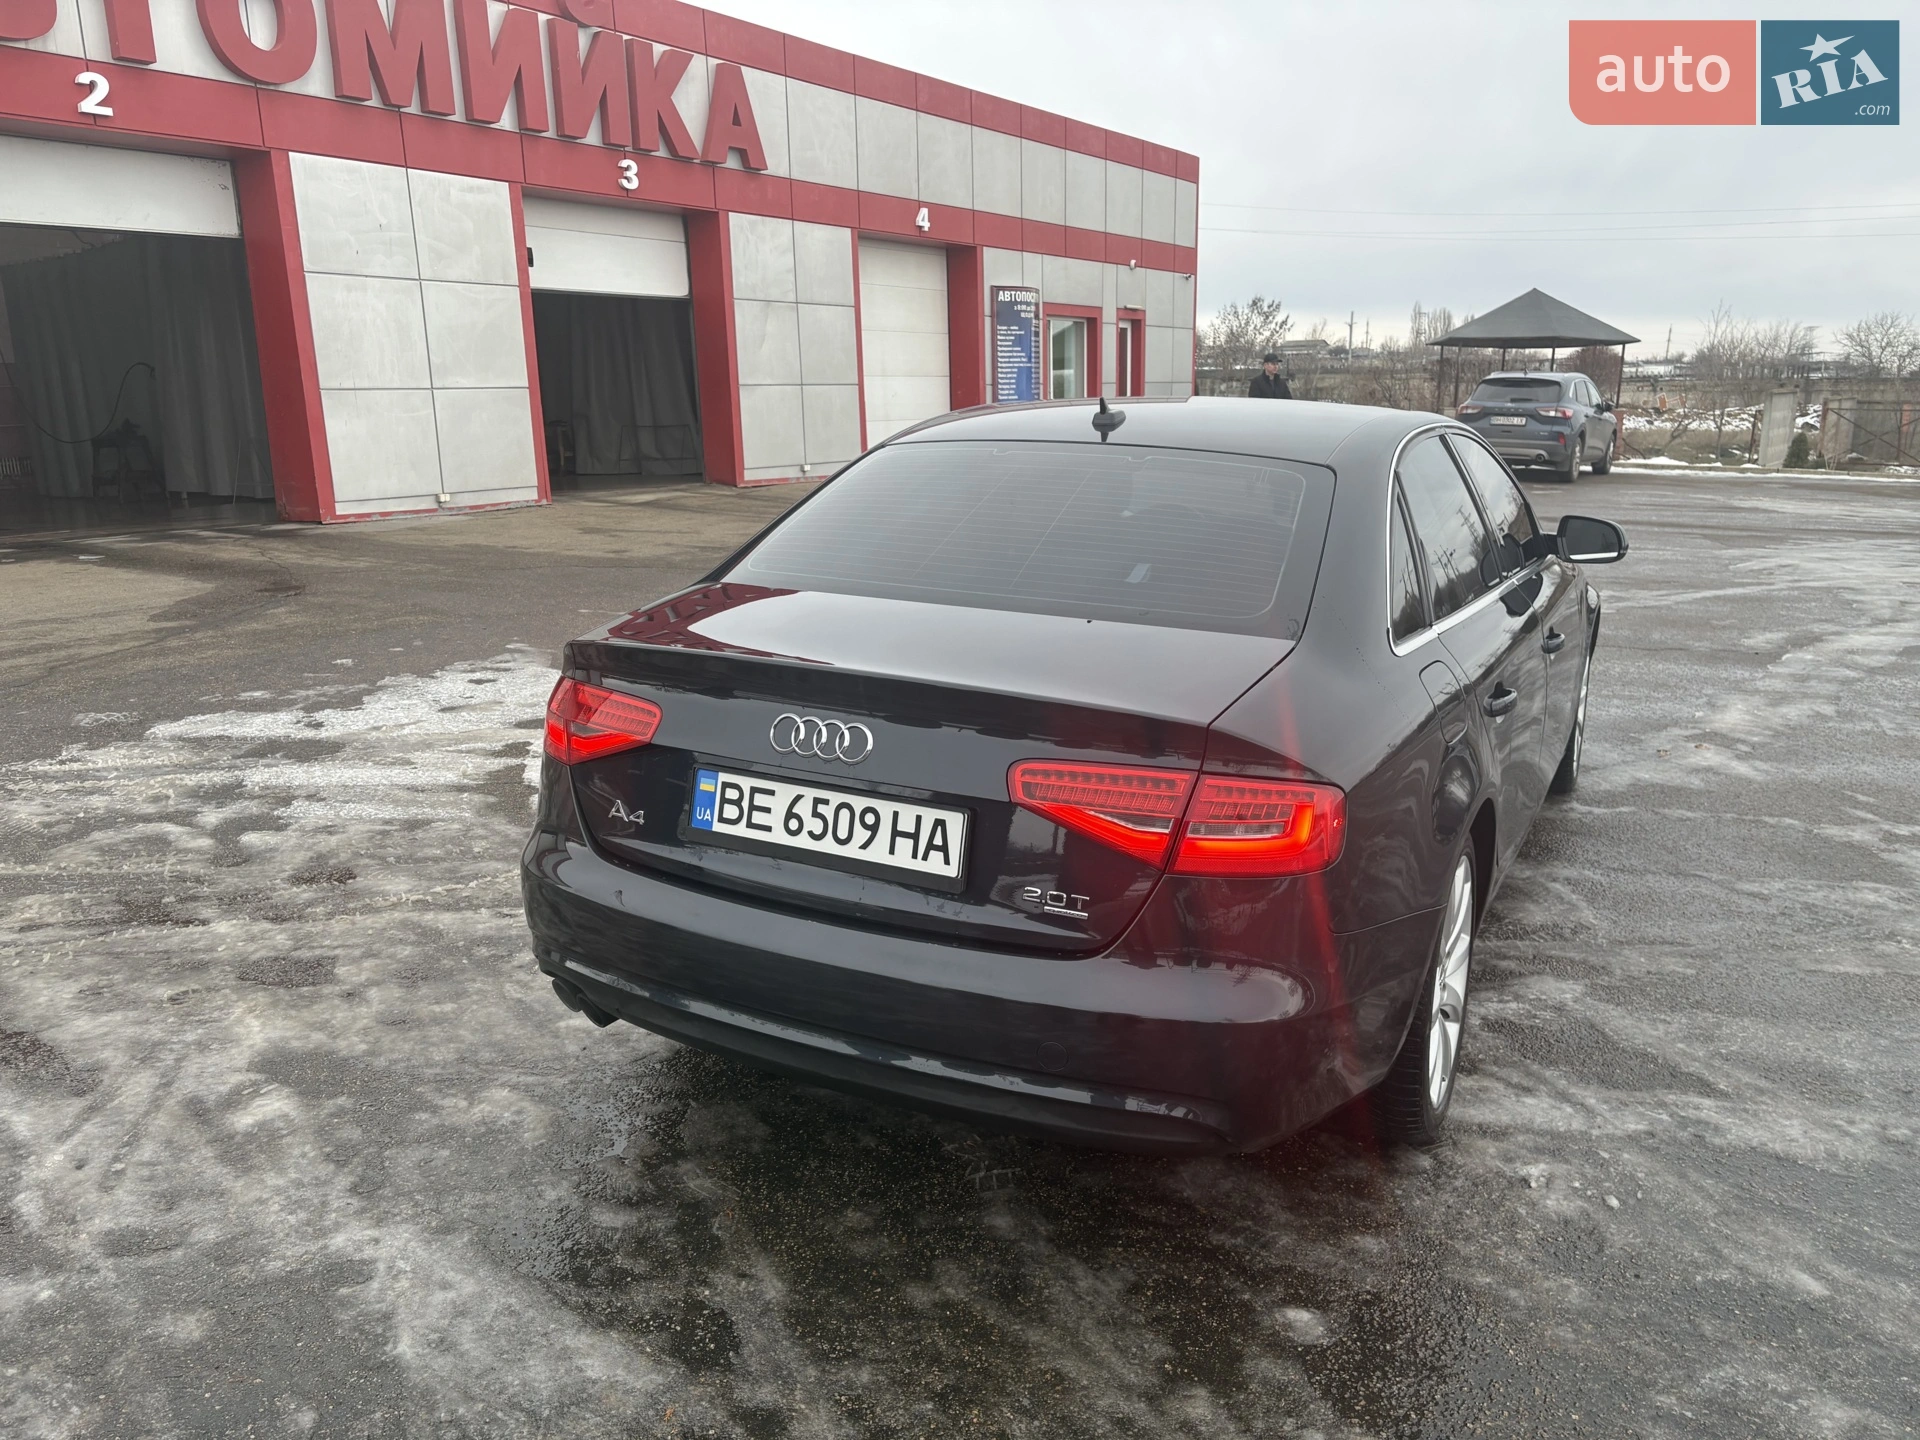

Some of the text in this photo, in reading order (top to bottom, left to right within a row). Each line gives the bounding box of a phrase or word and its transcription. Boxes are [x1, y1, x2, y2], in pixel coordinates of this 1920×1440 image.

[75, 71, 113, 116] 2
[617, 159, 639, 190] 3
[915, 207, 930, 231] 4
[608, 799, 645, 825] A4
[696, 780, 951, 866] UA BE 6509 HA
[1023, 886, 1090, 910] 2.0T
